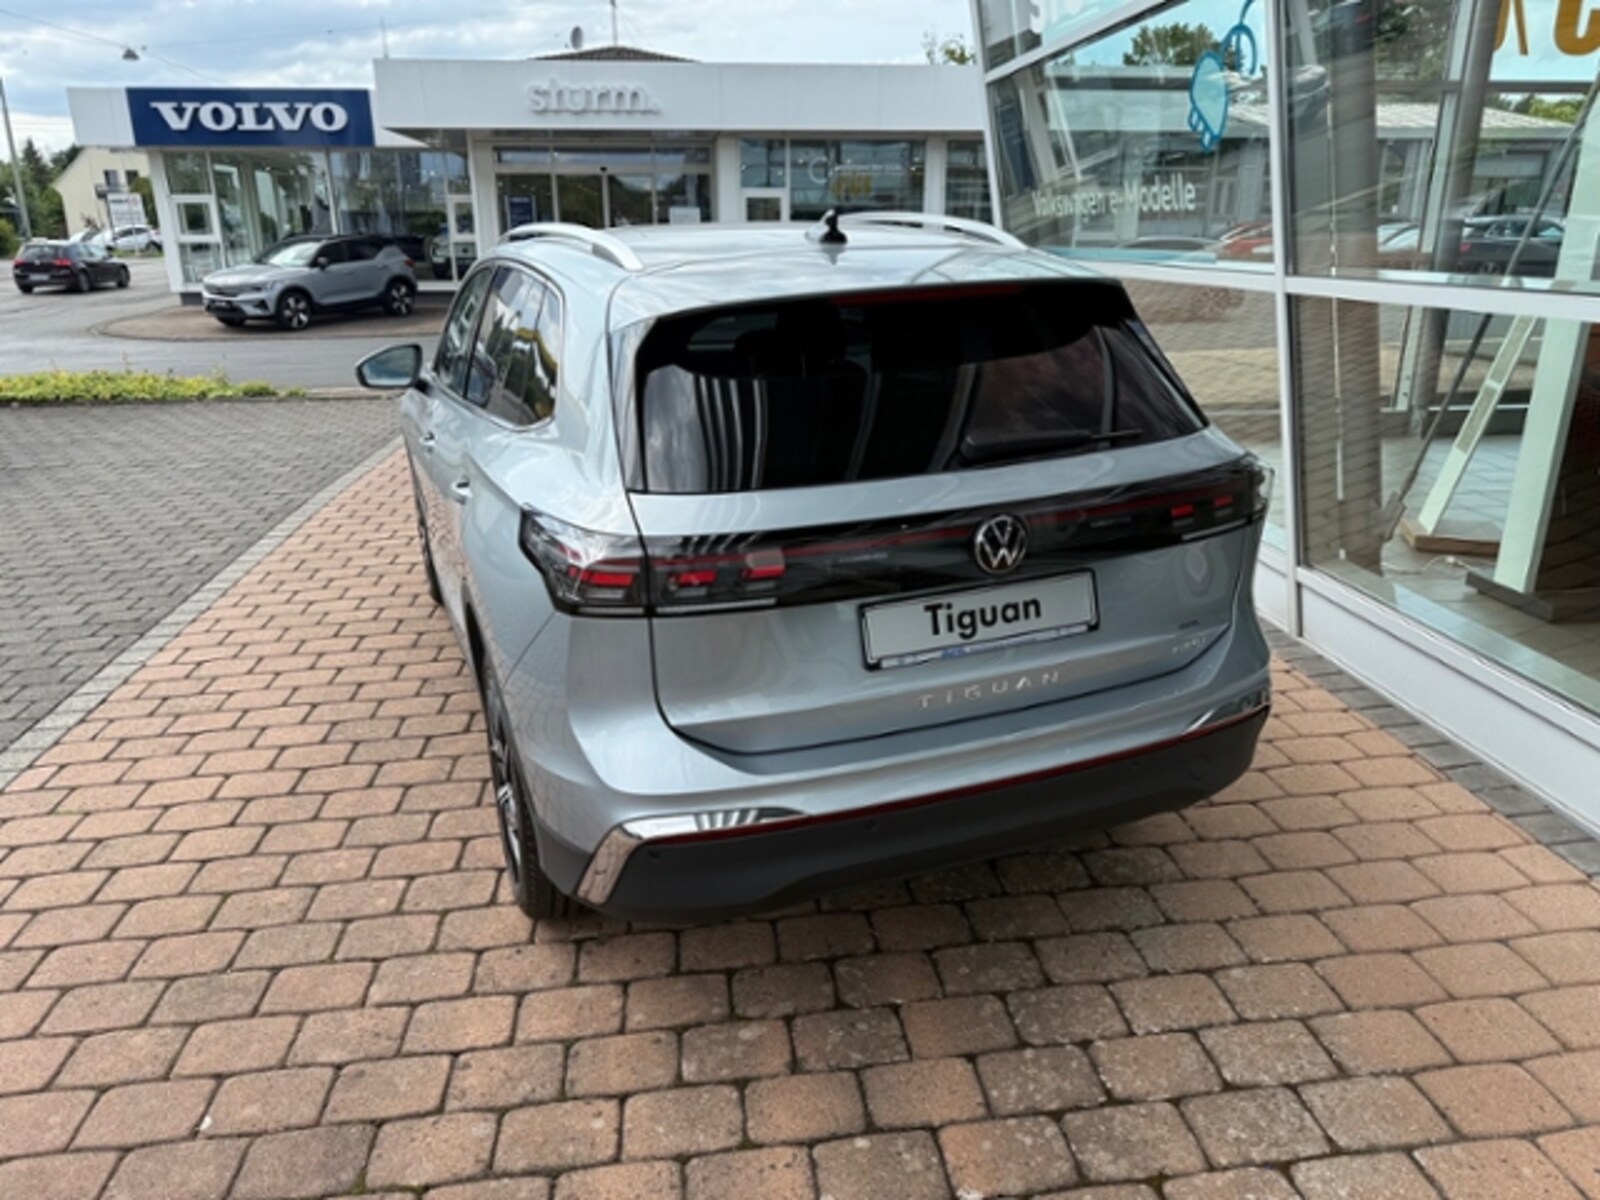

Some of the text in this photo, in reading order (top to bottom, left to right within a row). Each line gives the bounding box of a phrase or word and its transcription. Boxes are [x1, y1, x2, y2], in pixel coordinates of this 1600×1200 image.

[150, 101, 348, 131] VOLVO
[924, 598, 1041, 640] Tiguan
[918, 671, 1059, 708] TIGUAN
